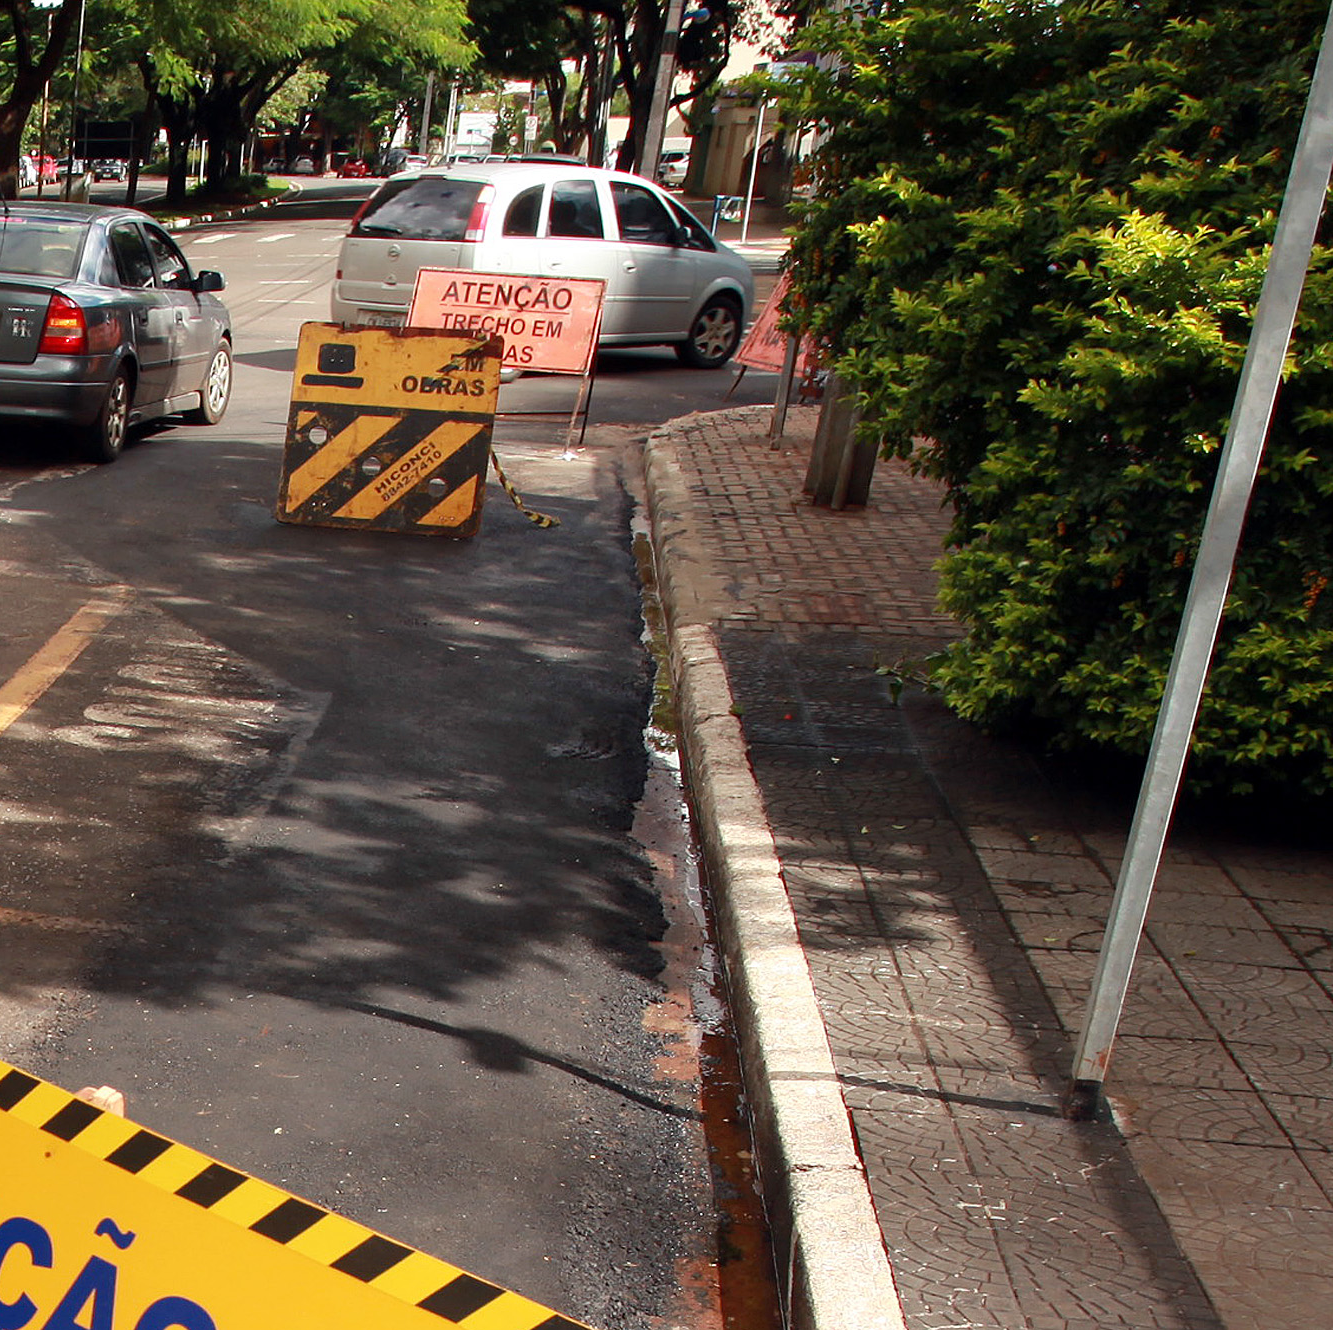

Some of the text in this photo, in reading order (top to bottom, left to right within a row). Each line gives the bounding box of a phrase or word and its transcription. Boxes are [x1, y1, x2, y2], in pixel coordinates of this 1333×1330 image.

[441, 281, 573, 312] ATENÇÃO
[532, 320, 563, 339] EM
[401, 375, 485, 397] OBRAS
